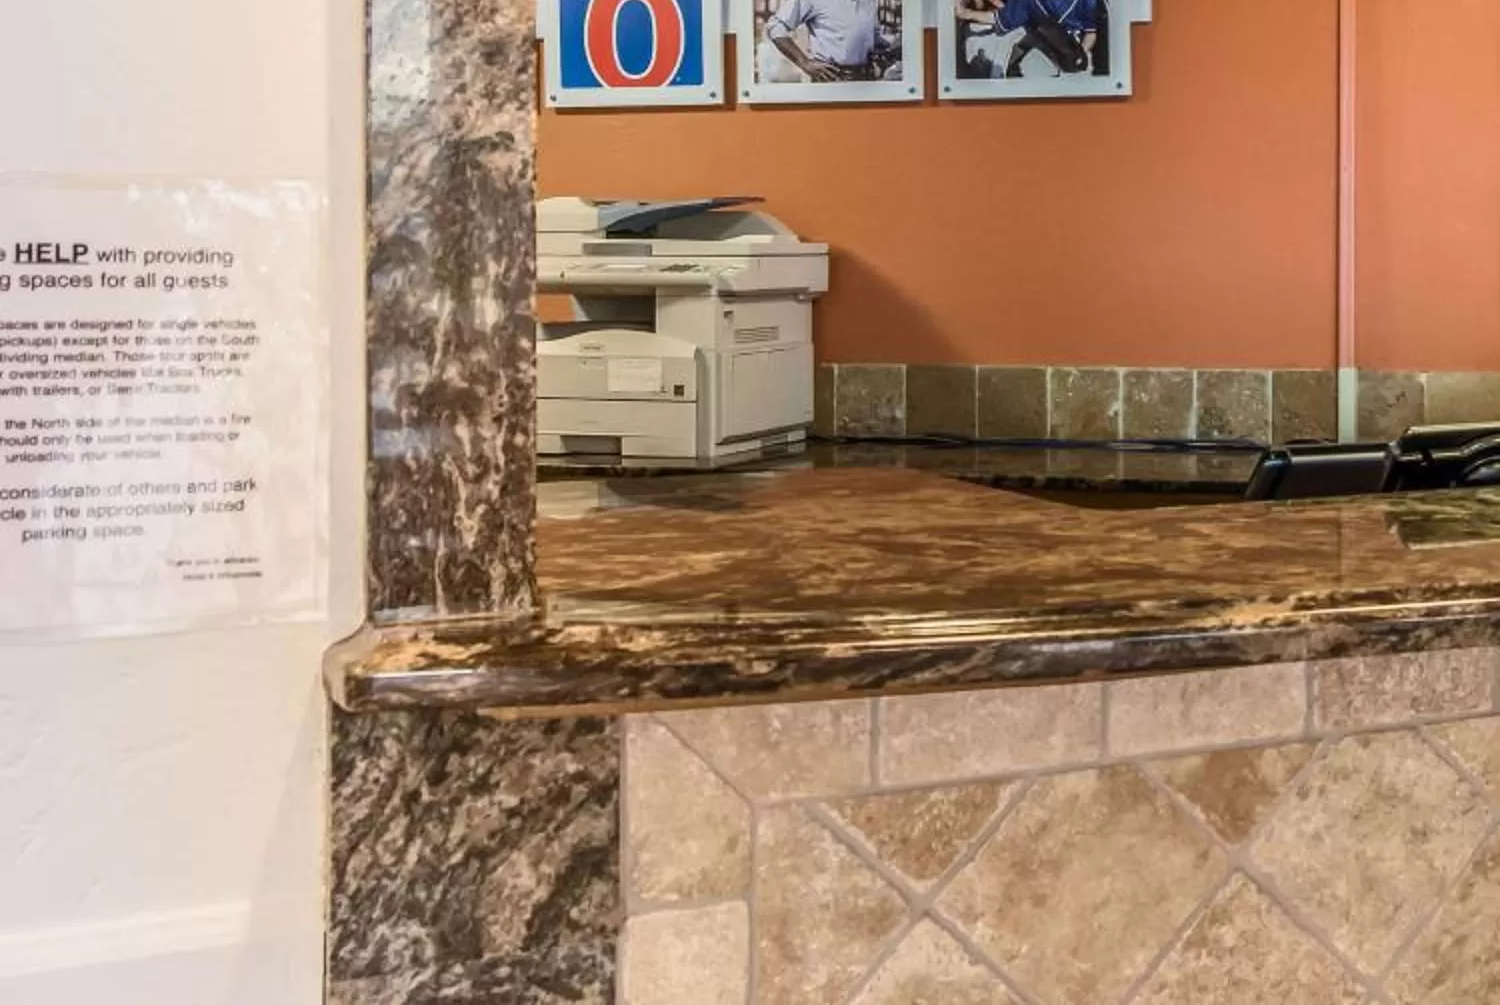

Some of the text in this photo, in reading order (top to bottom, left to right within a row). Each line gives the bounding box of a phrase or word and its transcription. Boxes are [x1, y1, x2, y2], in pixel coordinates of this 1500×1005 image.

[13, 242, 89, 265] HELP
[97, 246, 136, 264] with
[143, 246, 234, 267] providing
[19, 274, 93, 291] spaces
[101, 272, 126, 288] for
[134, 272, 156, 287] all
[163, 273, 229, 292] guests
[70, 319, 133, 333] designed
[62, 336, 108, 348] except
[112, 335, 129, 346] for
[8, 368, 77, 380] oversized
[82, 367, 136, 379] vehicles
[4, 419, 27, 430] the
[31, 417, 70, 429] North
[5, 451, 76, 464] unloading
[0, 477, 257, 500] considerate of others and park
[32, 505, 46, 519] in
[53, 505, 81, 520] the
[86, 498, 196, 520] appropriately
[201, 499, 245, 513] sized
[22, 527, 87, 545] parking
